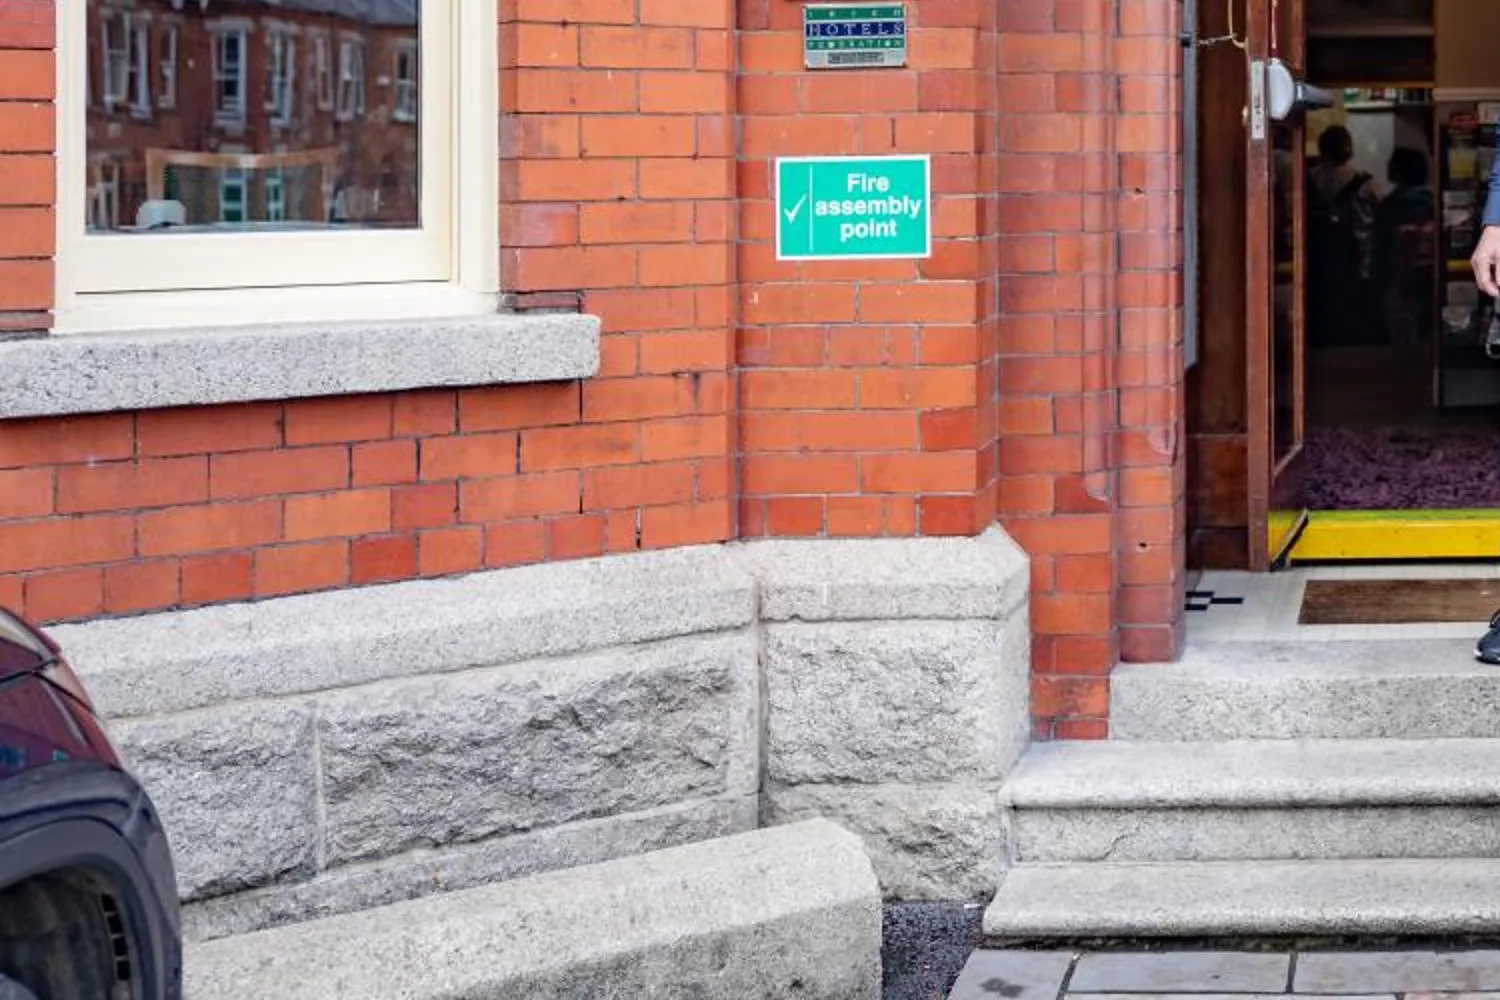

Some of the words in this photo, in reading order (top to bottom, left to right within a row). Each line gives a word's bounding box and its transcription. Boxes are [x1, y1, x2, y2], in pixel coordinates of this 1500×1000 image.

[809, 23, 903, 35] HOTELS
[847, 173, 889, 193] Fire
[815, 195, 922, 220] assembly
[840, 218, 897, 243] point
